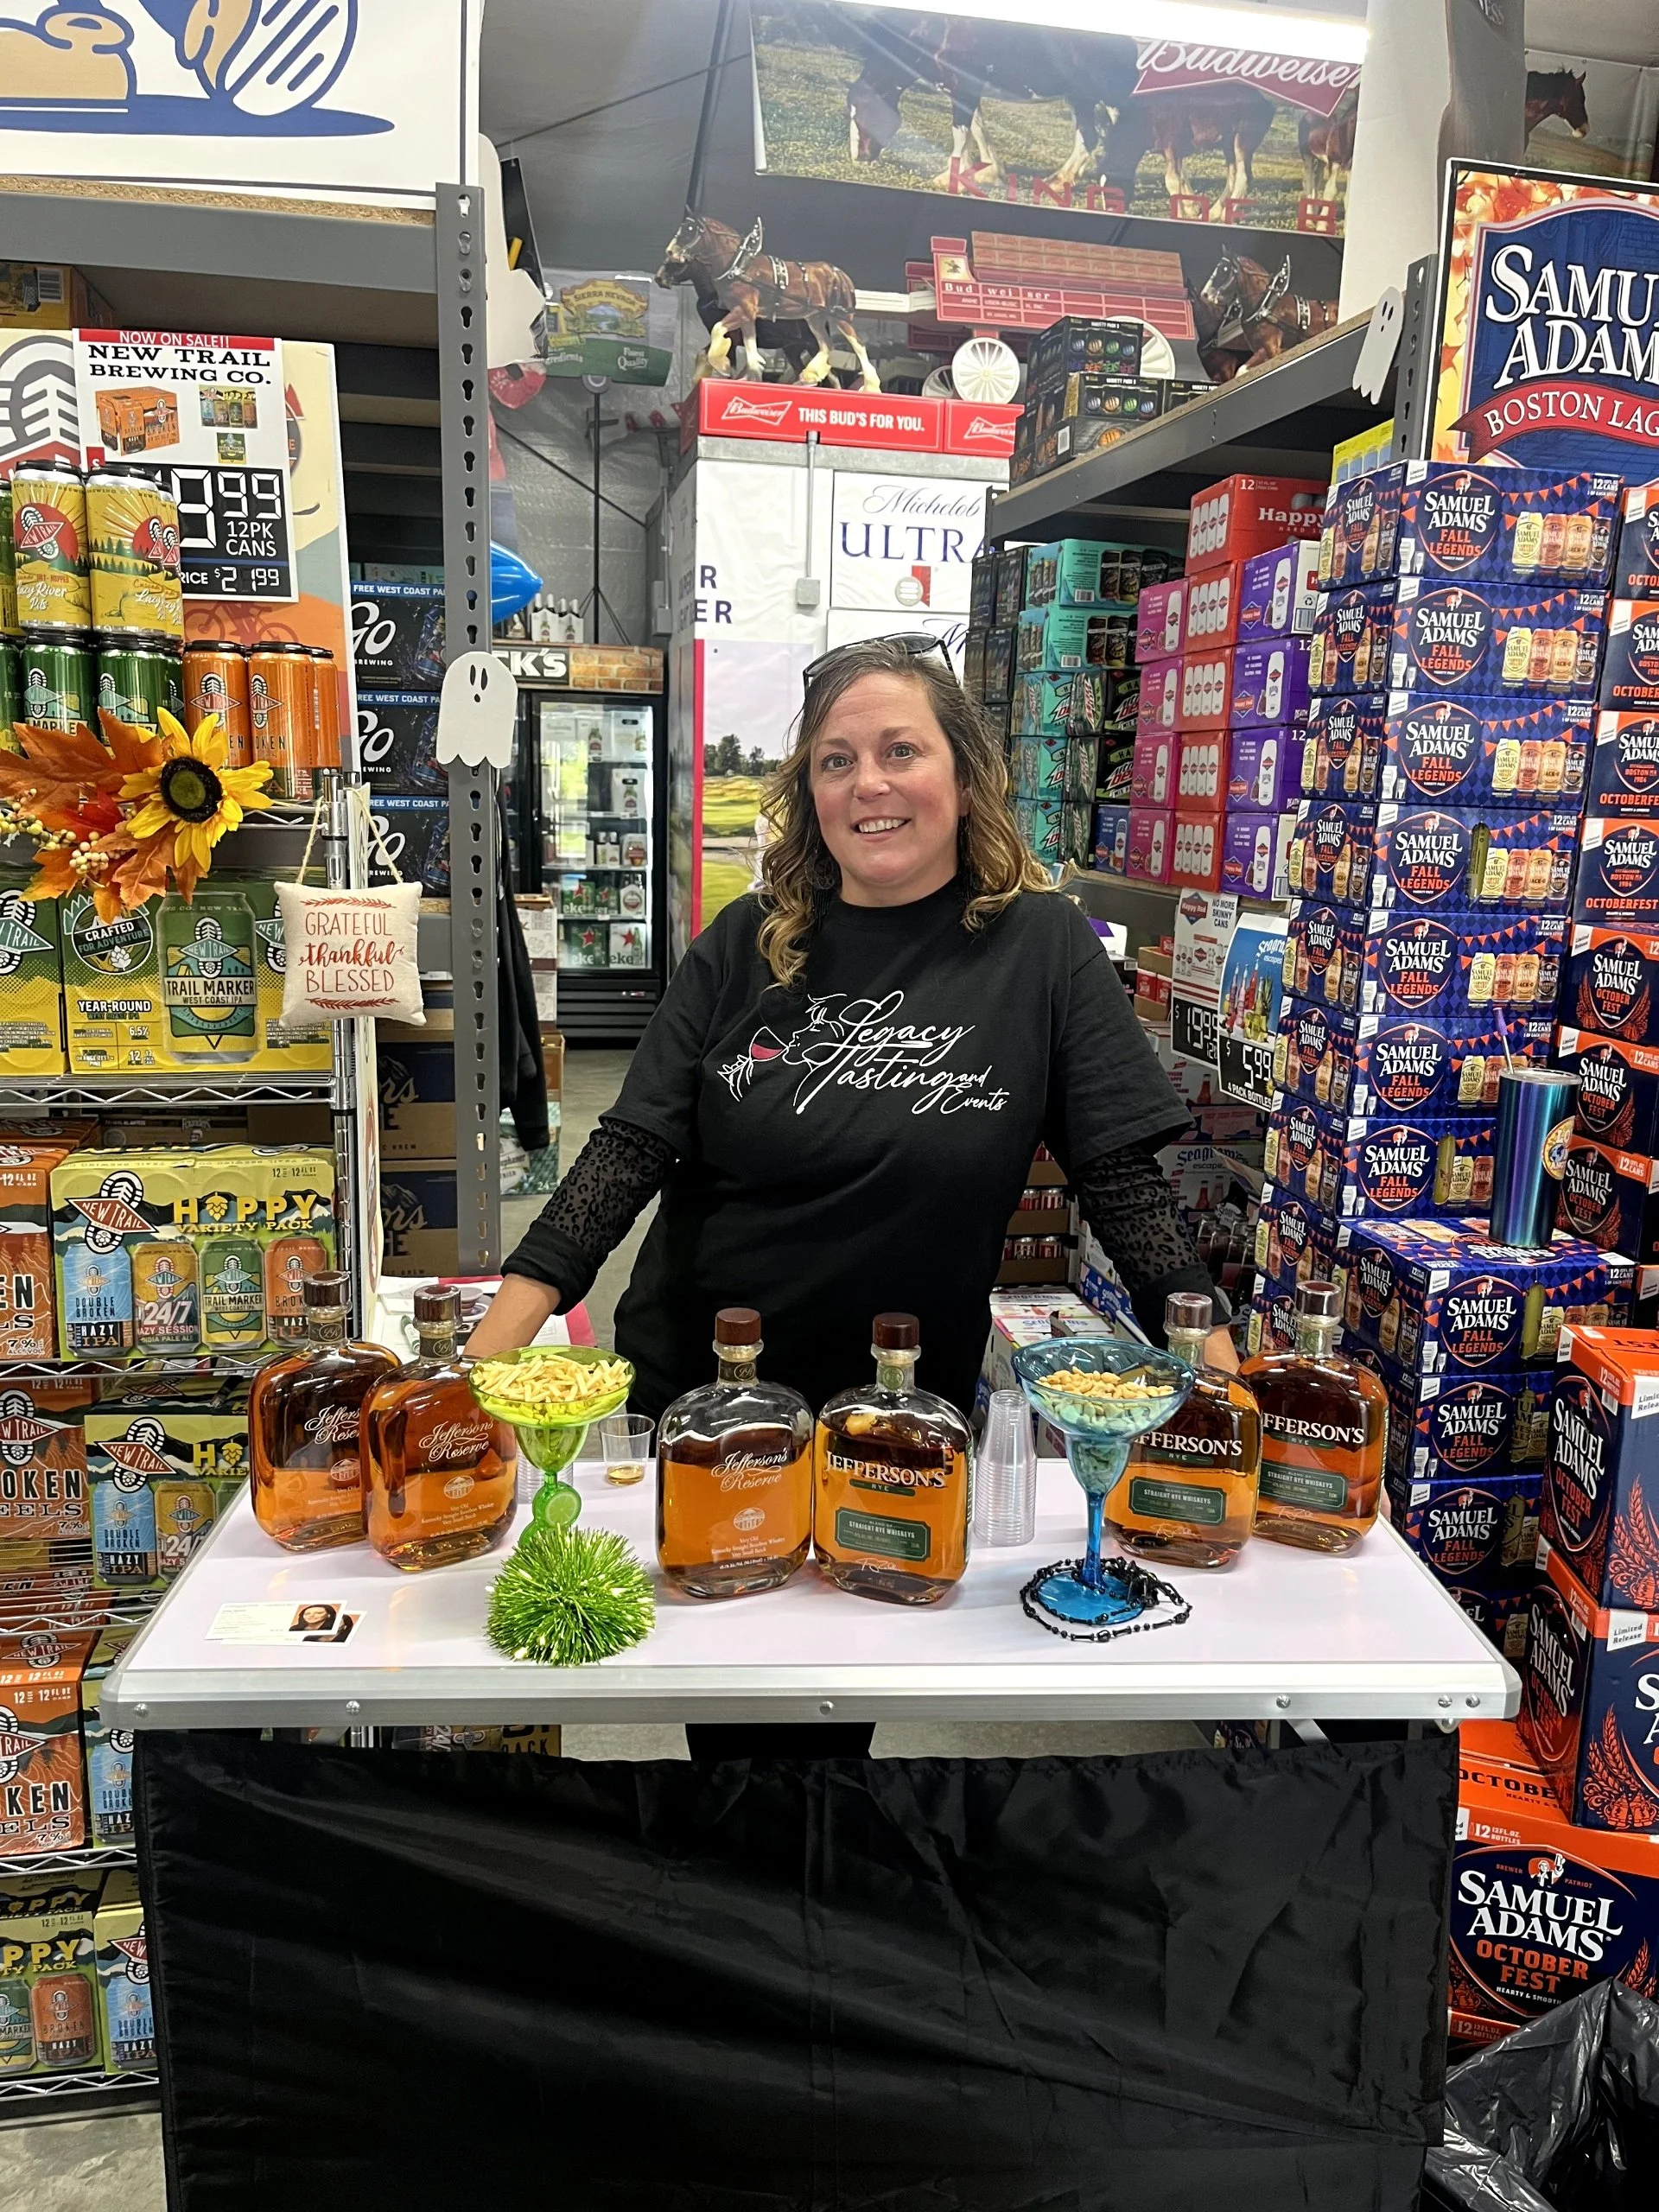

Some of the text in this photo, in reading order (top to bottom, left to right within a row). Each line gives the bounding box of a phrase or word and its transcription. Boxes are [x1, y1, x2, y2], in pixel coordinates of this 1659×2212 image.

[950, 156, 1257, 225] KING OF
[1485, 244, 1659, 327] SAMU
[574, 290, 604, 302] SIERRA
[119, 330, 229, 348] NOW ON SALE!!
[88, 345, 270, 367] NEW TRAIL
[617, 354, 648, 371] Quality
[90, 364, 272, 385] BREWING CO.
[728, 401, 925, 431] Budweiser THIS BUD'S FOR YOU.
[1484, 391, 1605, 438] BOSTON
[862, 484, 982, 518] Michelob
[1424, 491, 1496, 517] SAMUEL
[1258, 507, 1325, 527] Happy
[1427, 511, 1488, 533] ADAMS
[226, 520, 275, 539] 12PK
[1440, 528, 1471, 543] FALL
[226, 539, 277, 557] CANS
[1429, 542, 1482, 556] LEGENDS
[180, 571, 209, 585] RICE
[353, 584, 430, 594] FREE WEST COAST
[29, 597, 49, 611] Pils
[1415, 607, 1486, 632] SAMUEL
[1419, 626, 1479, 649] ADAMS
[1431, 645, 1462, 658] FALL
[1421, 657, 1473, 671] LEGENDS
[377, 694, 401, 702] WEST
[404, 695, 429, 703] COAST
[1405, 721, 1475, 744] SAMUEL
[1408, 741, 1469, 760] ADAMS
[1421, 755, 1452, 770] FALL
[1411, 767, 1464, 783] LEGENDS
[1395, 830, 1463, 854] SAMUEL
[1604, 839, 1657, 856] SAMUEL
[1399, 849, 1459, 868] ADAMS
[1606, 853, 1652, 868] ADAMS
[1409, 865, 1441, 879] FALL
[1399, 876, 1452, 891] LEGENDS
[1211, 899, 1235, 910] NO MORE
[1212, 908, 1233, 919] SKINNY
[1586, 898, 1659, 910] OCTOBERFEST
[84, 923, 135, 942] CRAFTED
[304, 912, 393, 938] GRATEFUL
[1214, 918, 1229, 929] CANS
[78, 928, 150, 954] FOR ADVENTURE
[297, 939, 406, 968] thankful
[1592, 953, 1642, 980] SAMUEL
[167, 979, 255, 996] TRAIL MARKER
[305, 969, 395, 993] BLESSED
[1594, 971, 1637, 996] ADAMS
[78, 1000, 152, 1013] YEAR-ROUND
[129, 1026, 149, 1037] 6.5%
[838, 990, 976, 1066] Legacy
[796, 1040, 993, 1116] Tasting and
[1579, 1057, 1627, 1089] SAMUEL
[940, 1083, 1010, 1116] Events
[1227, 1082, 1273, 1109] 4 PACK BOTTLES
[2, 1173, 14, 1186] 12
[1565, 1159, 1612, 1193] SAMUEL
[80, 1201, 143, 1230] NEW TRAIL
[176, 1219, 314, 1234] VARIETY PACK
[75, 1296, 115, 1308] DOUBLE
[204, 1294, 263, 1306] TRAIL MARKER
[1446, 1296, 1517, 1319] SAMUEL
[75, 1307, 116, 1318] BROKEN
[143, 1300, 193, 1325] 24/7
[81, 1324, 115, 1337] HAZY
[1450, 1313, 1511, 1332] ADAMS
[82, 1337, 119, 1347] IPA
[1462, 1329, 1494, 1343] FALL
[1452, 1341, 1504, 1354] LEGENDS
[1437, 1402, 1507, 1426] SAMUEL
[1441, 1420, 1500, 1439] ADAMS
[1554, 1398, 1605, 1476] SAMUEL
[429, 1438, 490, 1463] Reserve
[1453, 1435, 1485, 1448] FALL
[110, 1444, 165, 1471] NEW TRAIL
[711, 1446, 788, 1478] Jefferson's
[1443, 1446, 1495, 1459] LEGENDS
[825, 1450, 946, 1489] JEFFERSON'S
[1554, 1434, 1598, 1501] ADAMS
[721, 1471, 783, 1492] Reserve
[871, 1484, 890, 1492] RYE
[1267, 1470, 1334, 1489] STRAIGHT RYE WHISKEYS
[1143, 1487, 1211, 1505] STRAIGHT RYE WHISKEYS
[1556, 1465, 1592, 1520] OCTOBER
[1561, 1493, 1581, 1529] FEST
[104, 1529, 140, 1539] DOUBLE
[849, 1520, 916, 1539] STRAIGHT RYE WHISKEYS
[1613, 1624, 1643, 1637] Limited
[1613, 1632, 1642, 1645] Release
[1530, 1603, 1575, 1697] SAMUEL
[38, 1688, 50, 1701] 12
[1564, 1878, 1593, 1889] PATRIOT
[1458, 1870, 1624, 1936] SAMUEL
[1466, 1907, 1605, 1962] ADAMS
[33, 1961, 77, 1973] PACK
[1476, 1939, 1590, 1980] OCTOBER
[1501, 1964, 1560, 1994] FEST
[1496, 1986, 1523, 1999] HEARTY
[1532, 1993, 1561, 2006] SMOOTH
